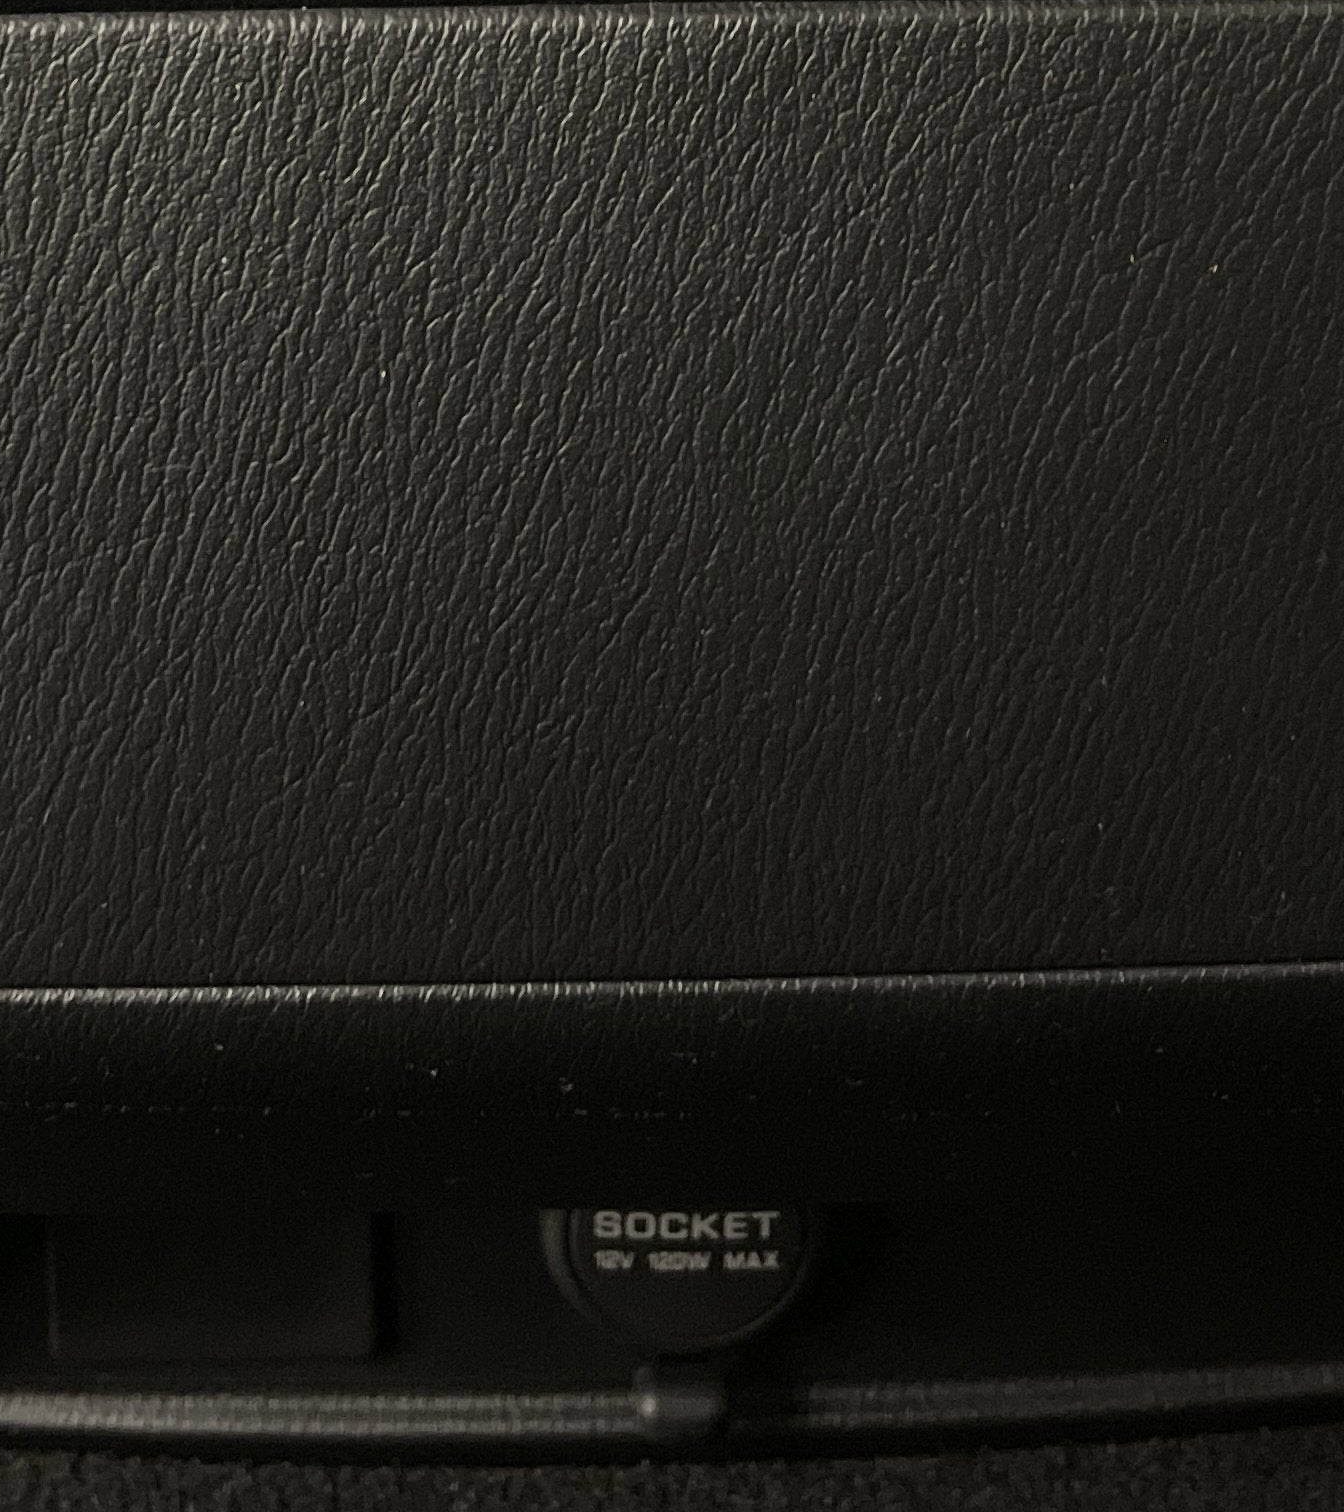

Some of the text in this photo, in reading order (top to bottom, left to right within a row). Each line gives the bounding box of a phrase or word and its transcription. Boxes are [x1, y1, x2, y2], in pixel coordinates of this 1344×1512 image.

[593, 1210, 779, 1240] SOCKET
[594, 1250, 779, 1272] 12V 120W MAX
